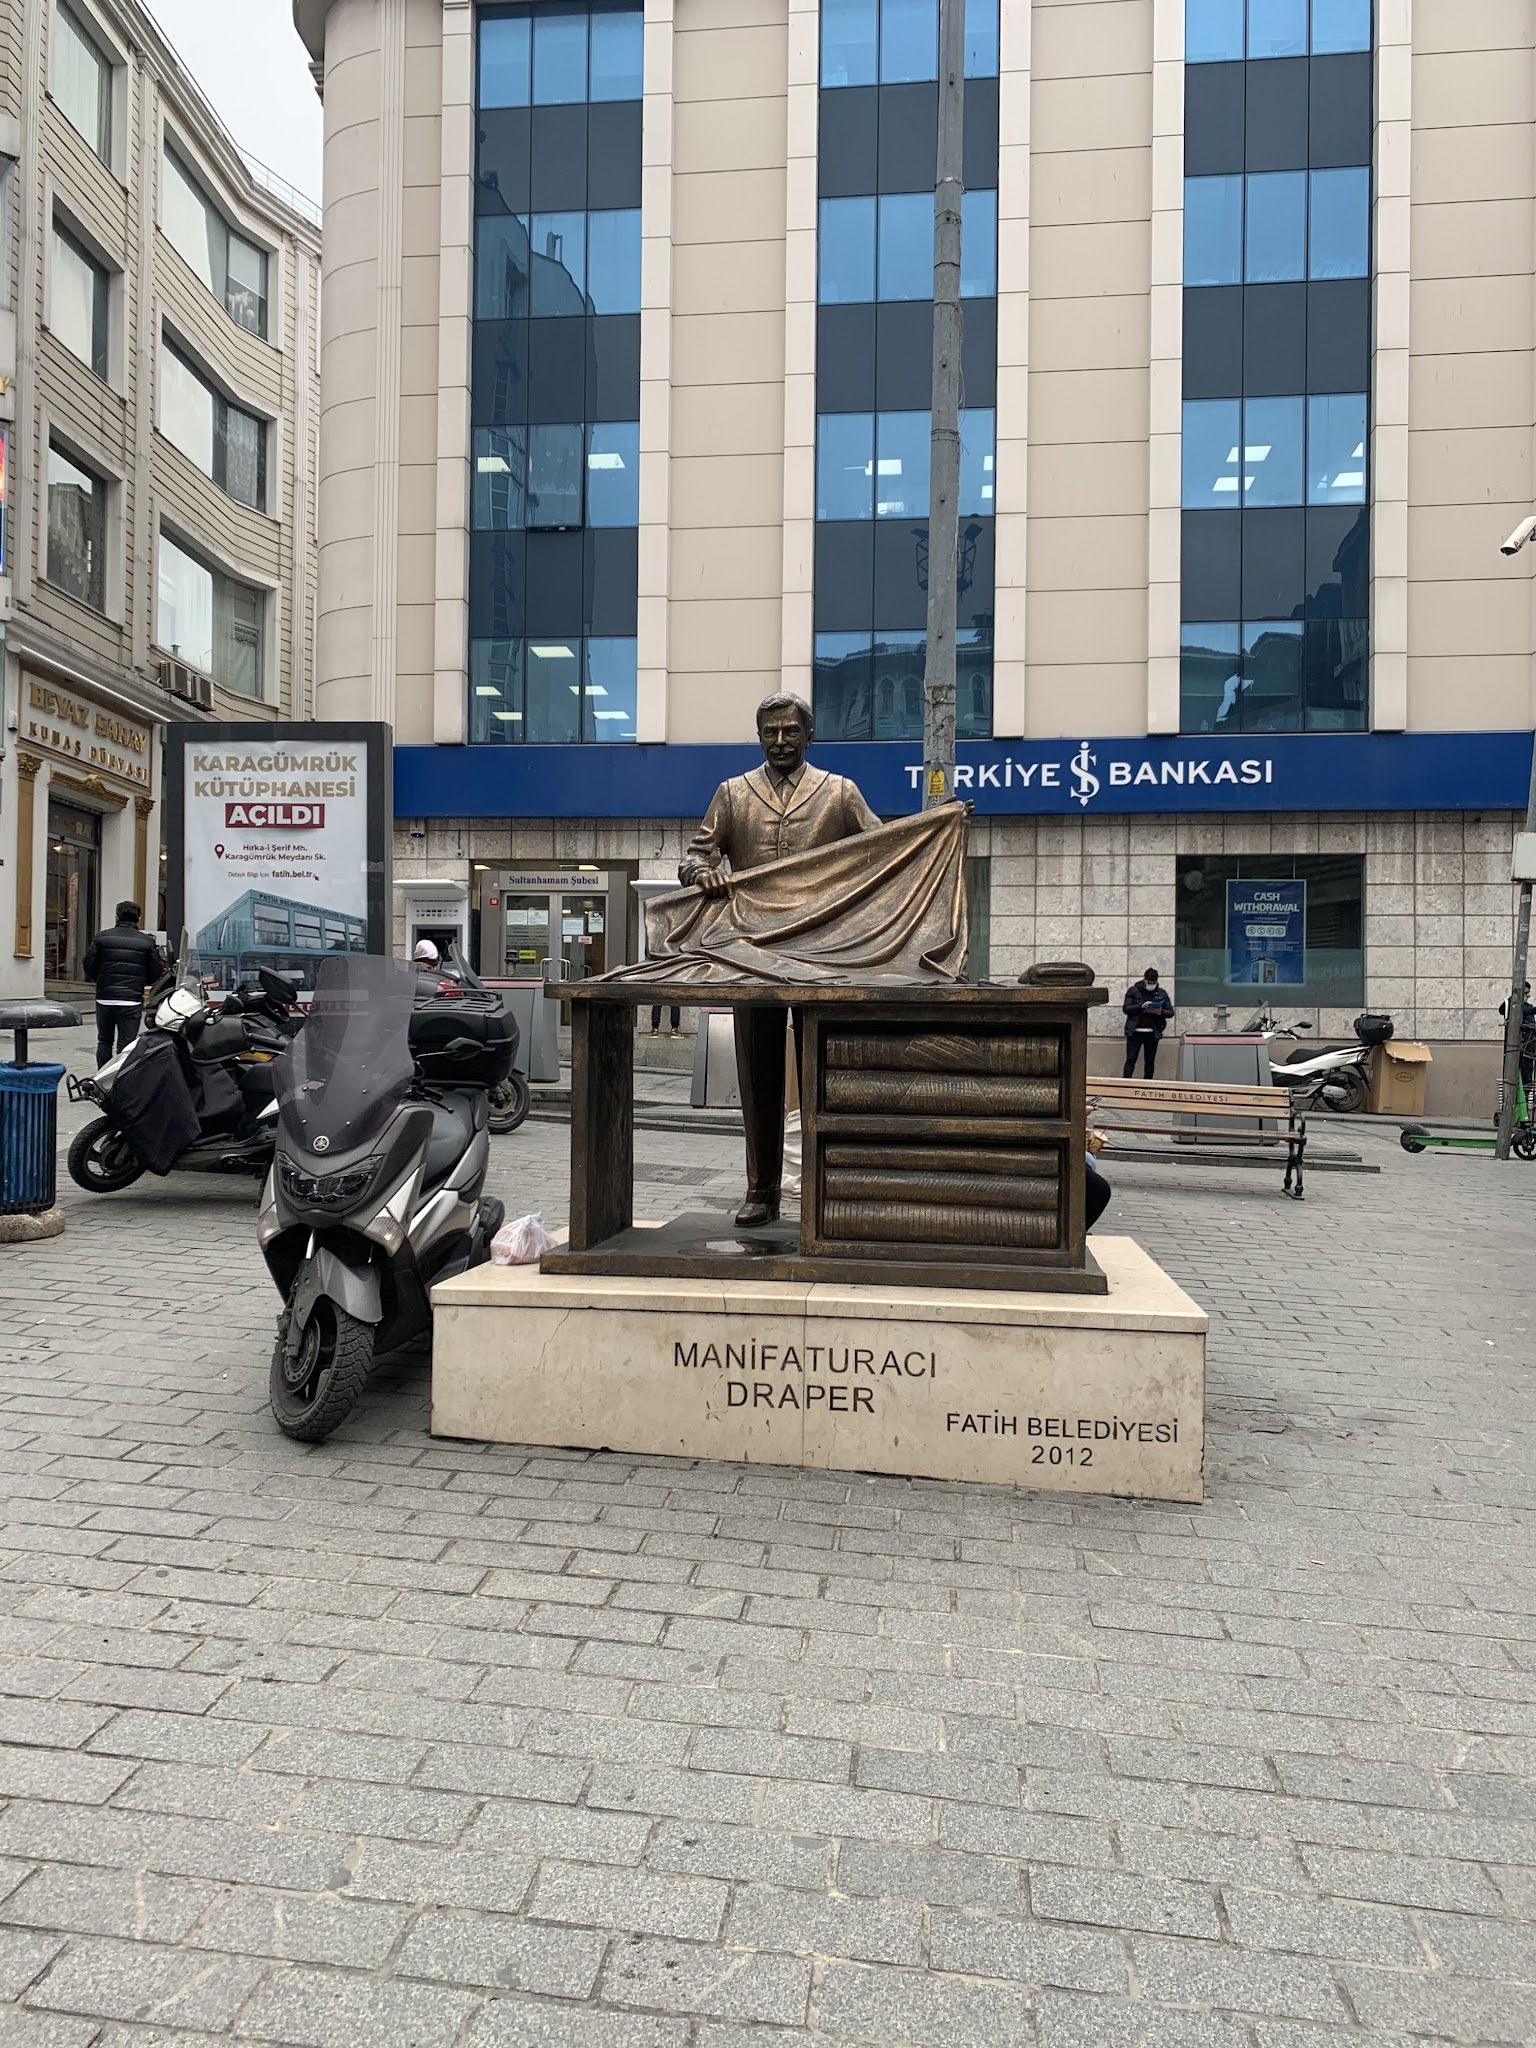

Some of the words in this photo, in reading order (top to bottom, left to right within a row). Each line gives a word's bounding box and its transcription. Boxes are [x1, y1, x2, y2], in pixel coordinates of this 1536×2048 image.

[30, 683, 90, 729] BEYAZ
[95, 713, 146, 754] SARAY
[29, 721, 82, 755] KUMAŞ
[89, 745, 147, 780] DÜNYASI
[193, 751, 357, 772] KARAGÜMRÜK
[904, 757, 1061, 790] TRKİYE
[1109, 759, 1273, 786] BANKASI
[194, 776, 355, 797] KÜTÜPHANESİ
[228, 805, 320, 826] AÇILDI
[225, 853, 277, 862] Karagümrük
[278, 853, 313, 862] Meydanı
[314, 853, 327, 861] Sk.
[271, 843, 291, 853] Şerif
[292, 844, 308, 852] Mh.
[271, 870, 312, 878] fatih.bel.tr
[508, 876, 569, 885] Sultanhamam
[570, 875, 599, 886] Şubesi
[1233, 902, 1300, 912] WITHDRAWAL
[1253, 892, 1280, 901] CASH
[674, 1338, 937, 1379] MANİFATURACI
[726, 1381, 876, 1414] DRAPER
[946, 1409, 1018, 1436] FATİH
[1027, 1414, 1180, 1444] BELEDİYESİ
[1031, 1446, 1094, 1468] 2012
